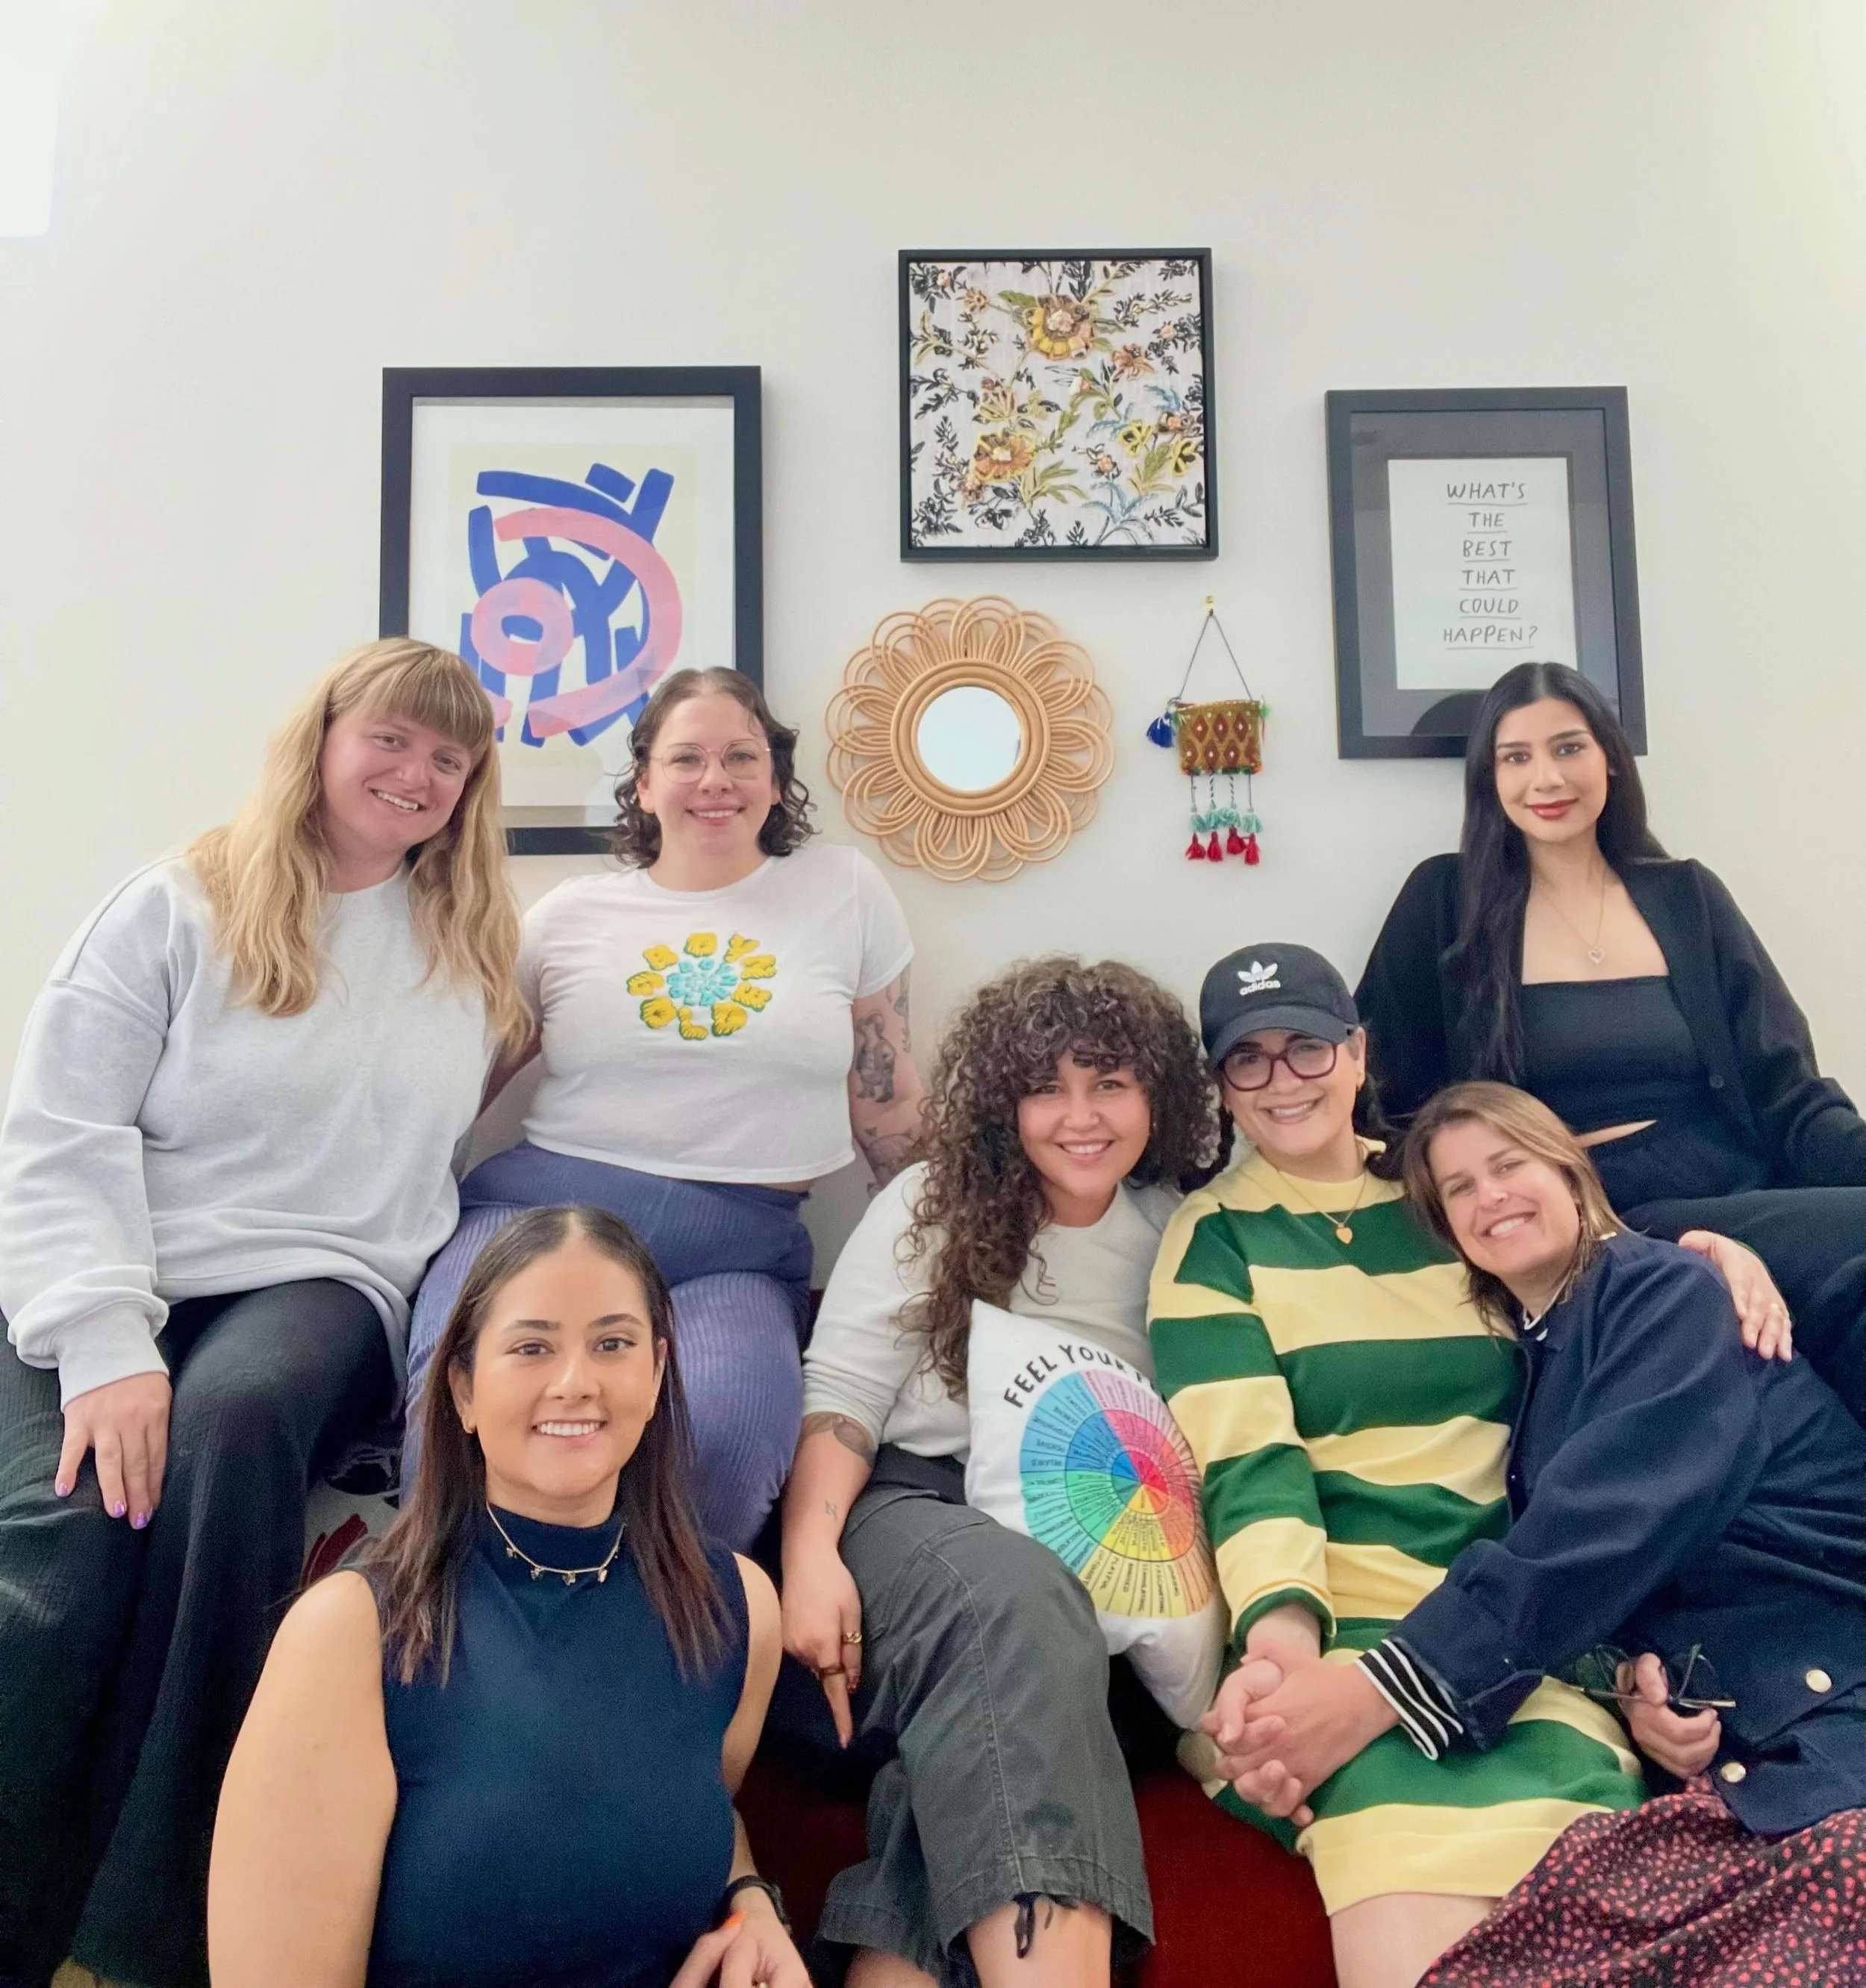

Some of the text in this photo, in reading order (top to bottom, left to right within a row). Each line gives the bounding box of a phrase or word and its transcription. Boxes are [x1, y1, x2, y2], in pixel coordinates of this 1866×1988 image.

[1447, 482, 1526, 499] WHAT'S
[1467, 511, 1505, 529] THE
[1462, 540, 1512, 558] BEST
[1461, 569, 1515, 585] THAT
[1458, 597, 1519, 614] COULD
[1443, 624, 1538, 644] HAPPEN?
[1240, 979, 1281, 996] adidas
[1003, 1355, 1058, 1409] FEEL
